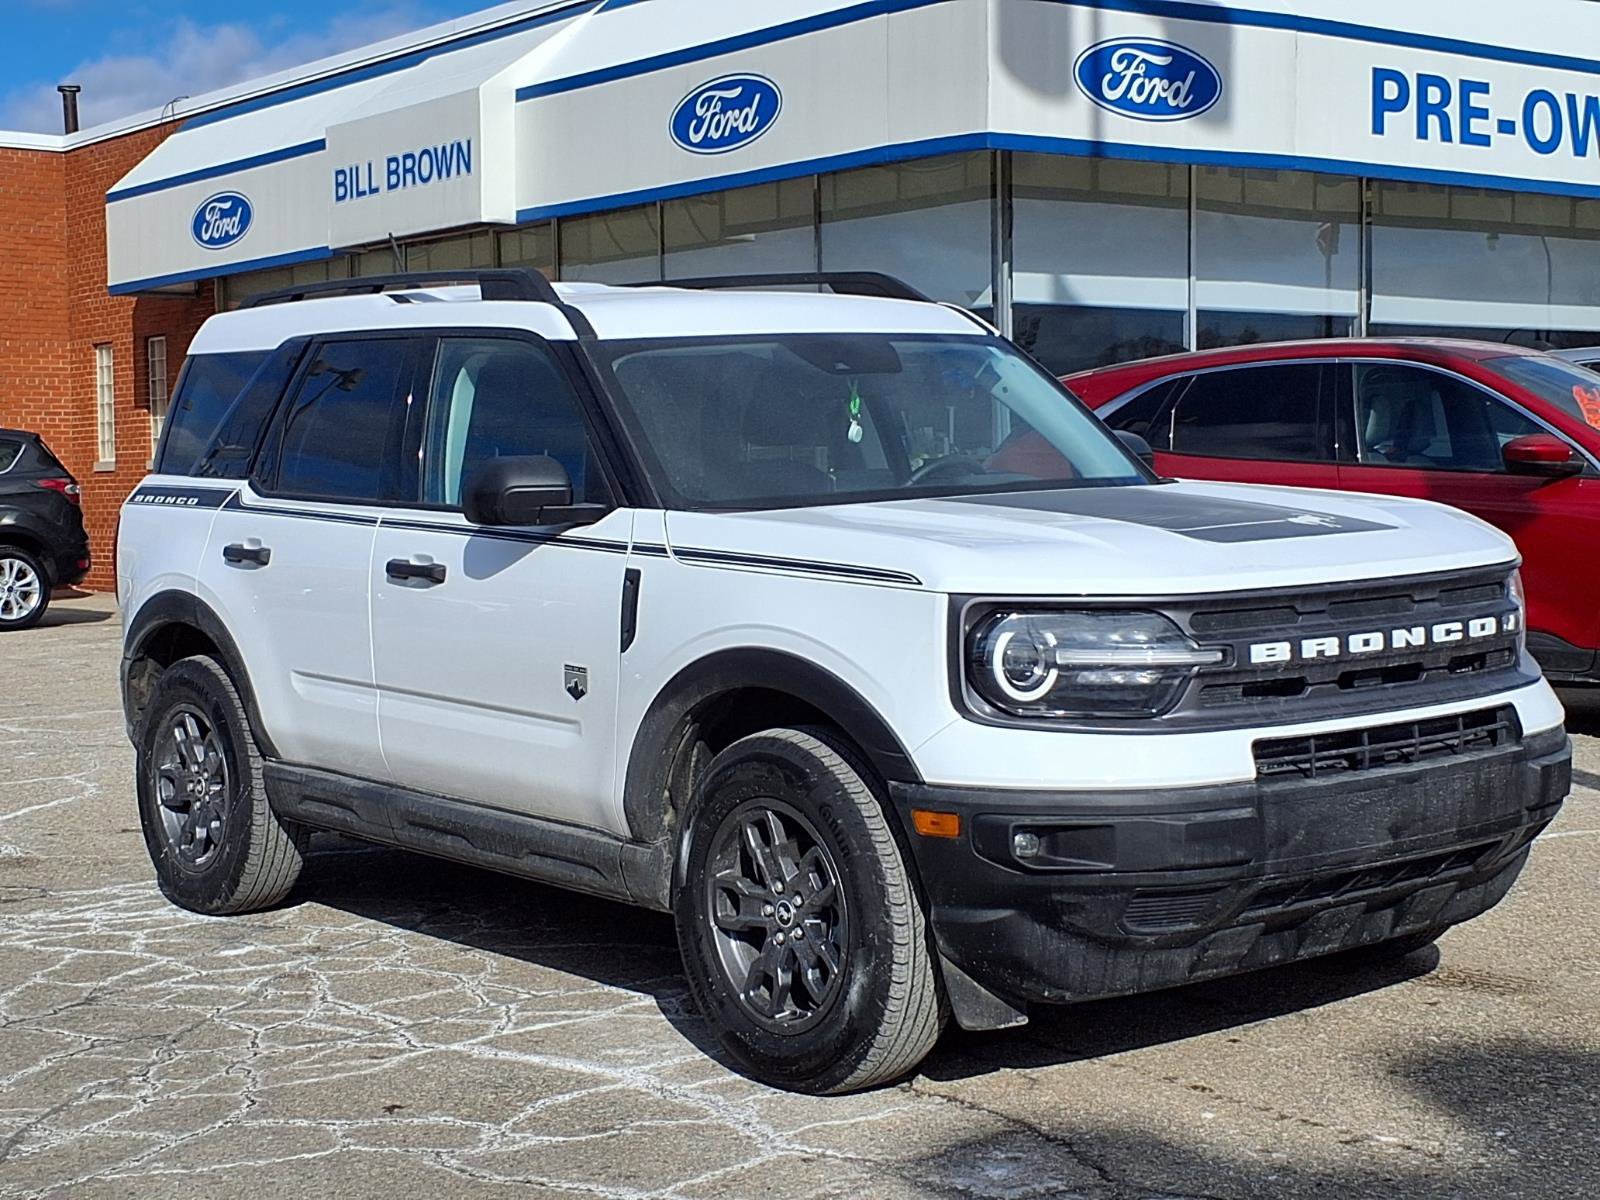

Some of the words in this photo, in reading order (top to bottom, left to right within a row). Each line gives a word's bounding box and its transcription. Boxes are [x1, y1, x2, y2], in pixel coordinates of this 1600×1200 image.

[1102, 47, 1196, 108] Ford
[689, 86, 761, 144] Ford
[335, 161, 380, 202] BILL
[386, 139, 472, 191] BROWN
[201, 200, 243, 241] Ford
[134, 494, 199, 505] BRONCO
[1250, 616, 1497, 664] BRONCO
